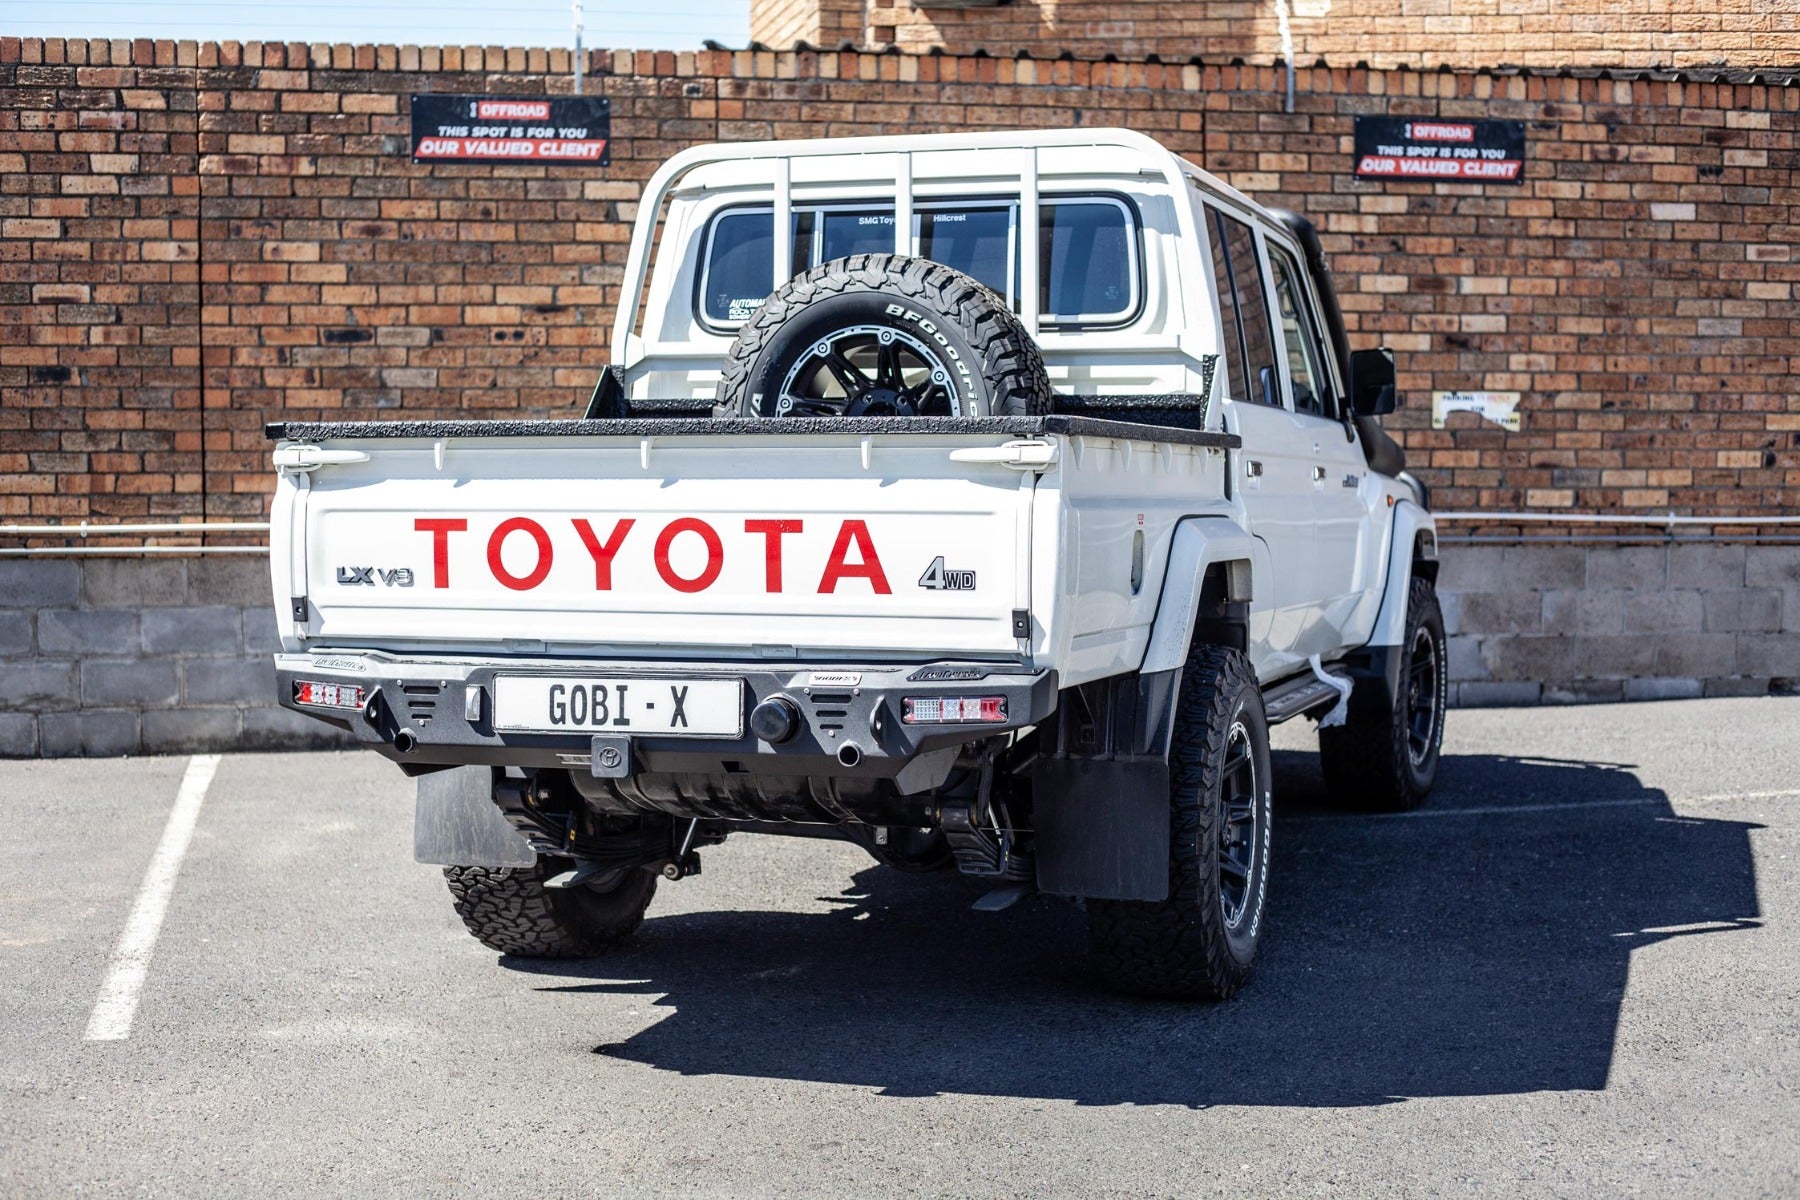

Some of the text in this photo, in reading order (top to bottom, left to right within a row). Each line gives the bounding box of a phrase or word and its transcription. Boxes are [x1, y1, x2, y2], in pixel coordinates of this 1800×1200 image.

[480, 103, 547, 118] OFFROAD
[438, 126, 587, 139] THIS SPOT IS FOR YOU
[1413, 124, 1472, 139] OFFROAD
[420, 140, 601, 157] OUR VALUED CLIENT
[1377, 145, 1506, 160] THIS SPOT IS FOR YOU
[1360, 158, 1517, 176] OUR VALUED CLIENT
[859, 214, 966, 226] SMG Toy Hillcrest
[885, 303, 978, 418] BFGoodric
[414, 517, 893, 595] TOYOTA
[337, 566, 414, 587] LX V8
[918, 556, 976, 590] 4WD
[549, 684, 630, 726] GOBI
[669, 685, 689, 728] X
[1250, 791, 1271, 937] BFGoodrich
